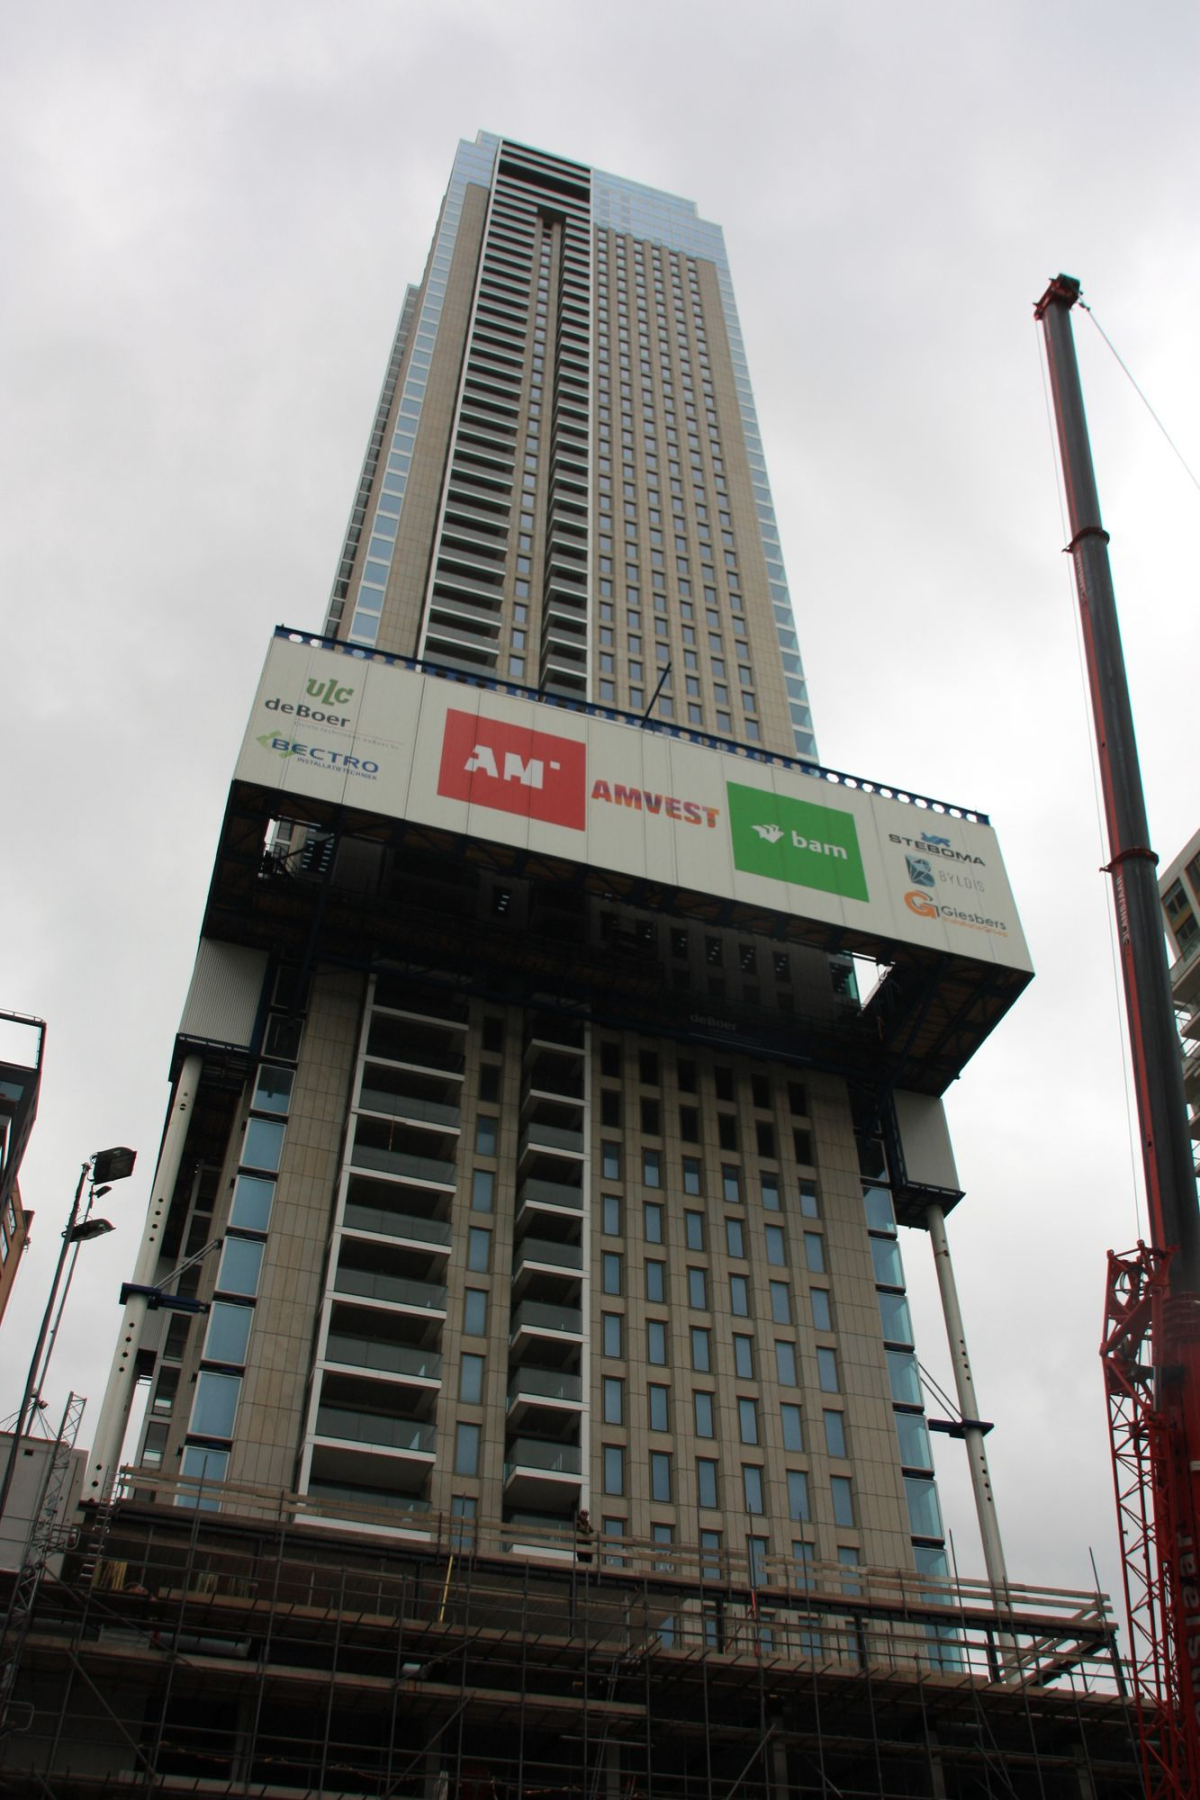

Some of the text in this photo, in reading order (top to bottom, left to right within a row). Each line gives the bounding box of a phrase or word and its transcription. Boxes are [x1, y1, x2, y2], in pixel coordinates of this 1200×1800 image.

[272, 738, 380, 774] BECTRO
[591, 779, 720, 829] AMVEST
[791, 831, 849, 860] bam
[888, 833, 987, 867] STEBOMA
[938, 870, 986, 893] BYLDIS
[940, 905, 1008, 931] Giesbers
